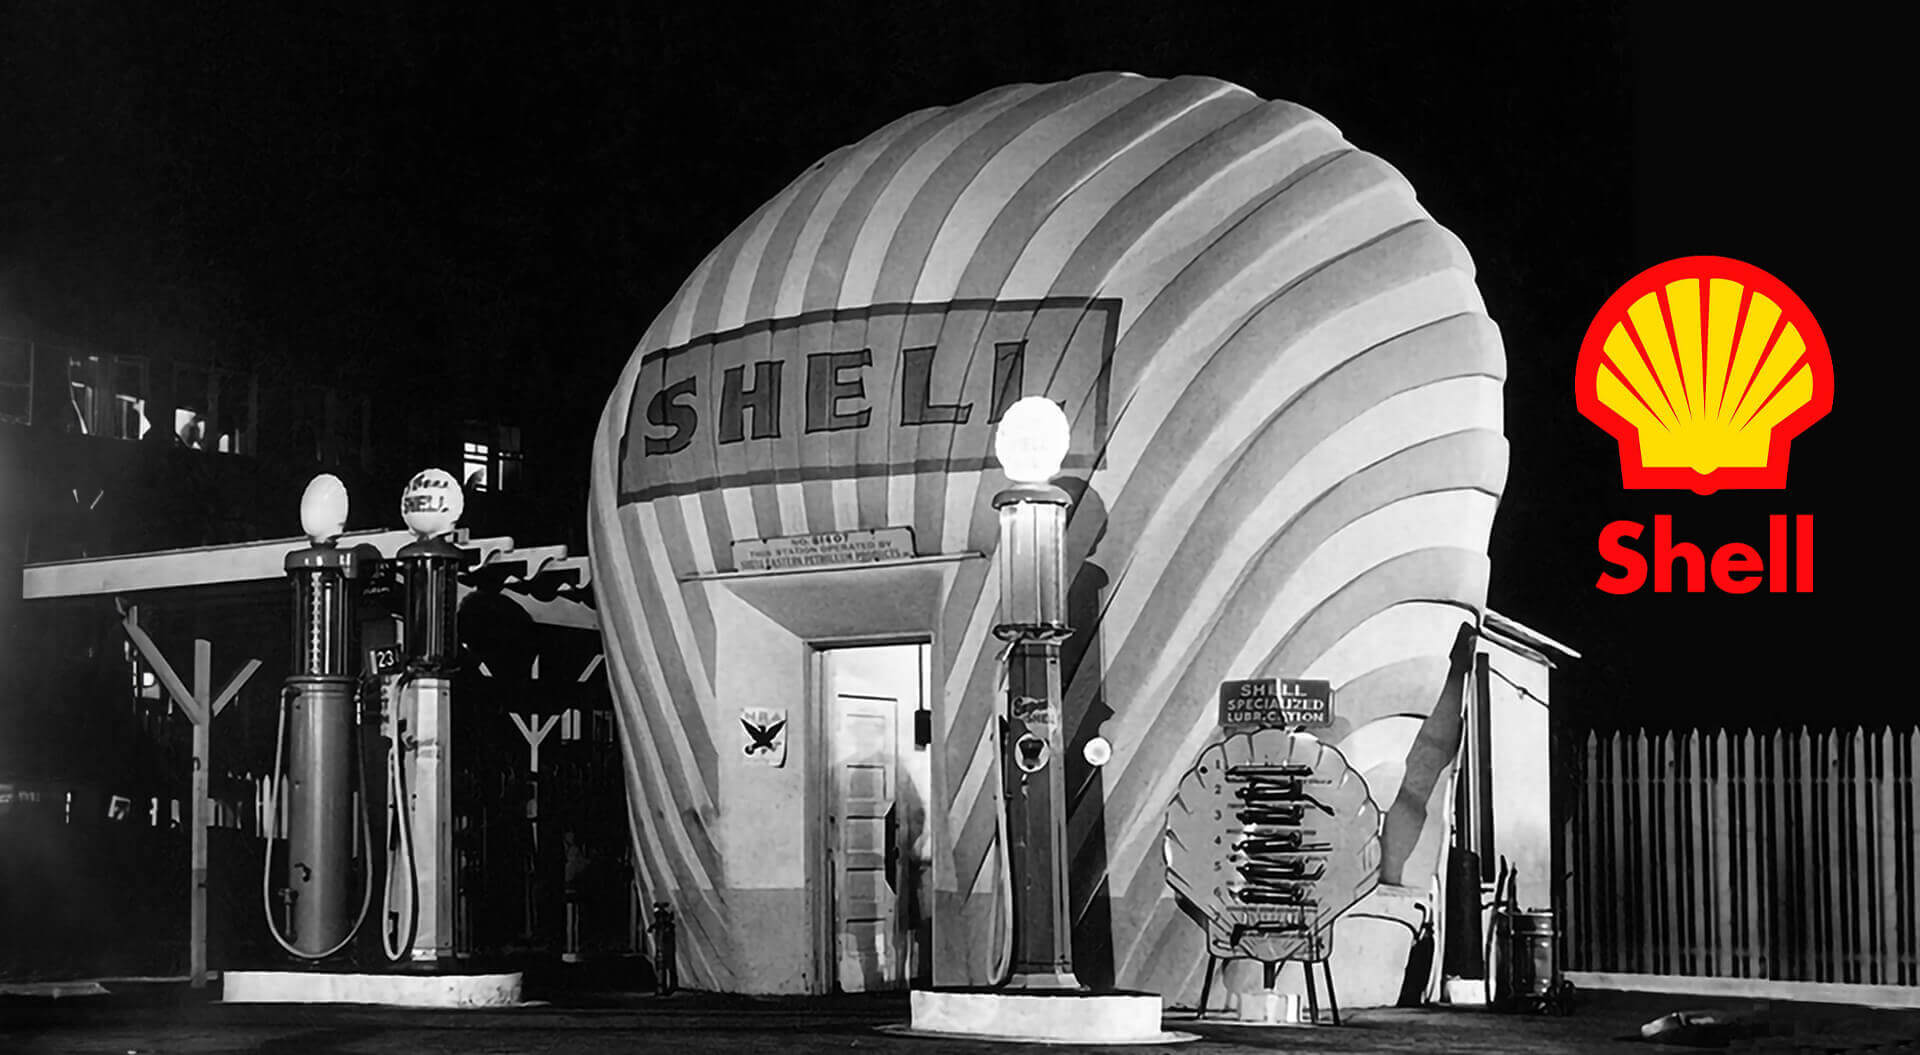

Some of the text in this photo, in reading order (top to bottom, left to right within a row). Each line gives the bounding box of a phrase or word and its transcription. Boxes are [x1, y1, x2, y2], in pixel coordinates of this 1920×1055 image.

[645, 340, 1066, 457] SHELL
[775, 546, 817, 556] STATION
[819, 542, 875, 553] OPERATED
[879, 540, 892, 549] BY
[377, 650, 394, 668] 23
[1240, 684, 1307, 697] SHELL
[1227, 698, 1324, 710] SPECIALIZED
[744, 711, 781, 721] NRA
[1214, 784, 1222, 795] 2
[1214, 810, 1222, 820] 3
[1214, 835, 1222, 845] 4
[1214, 860, 1222, 872] 5
